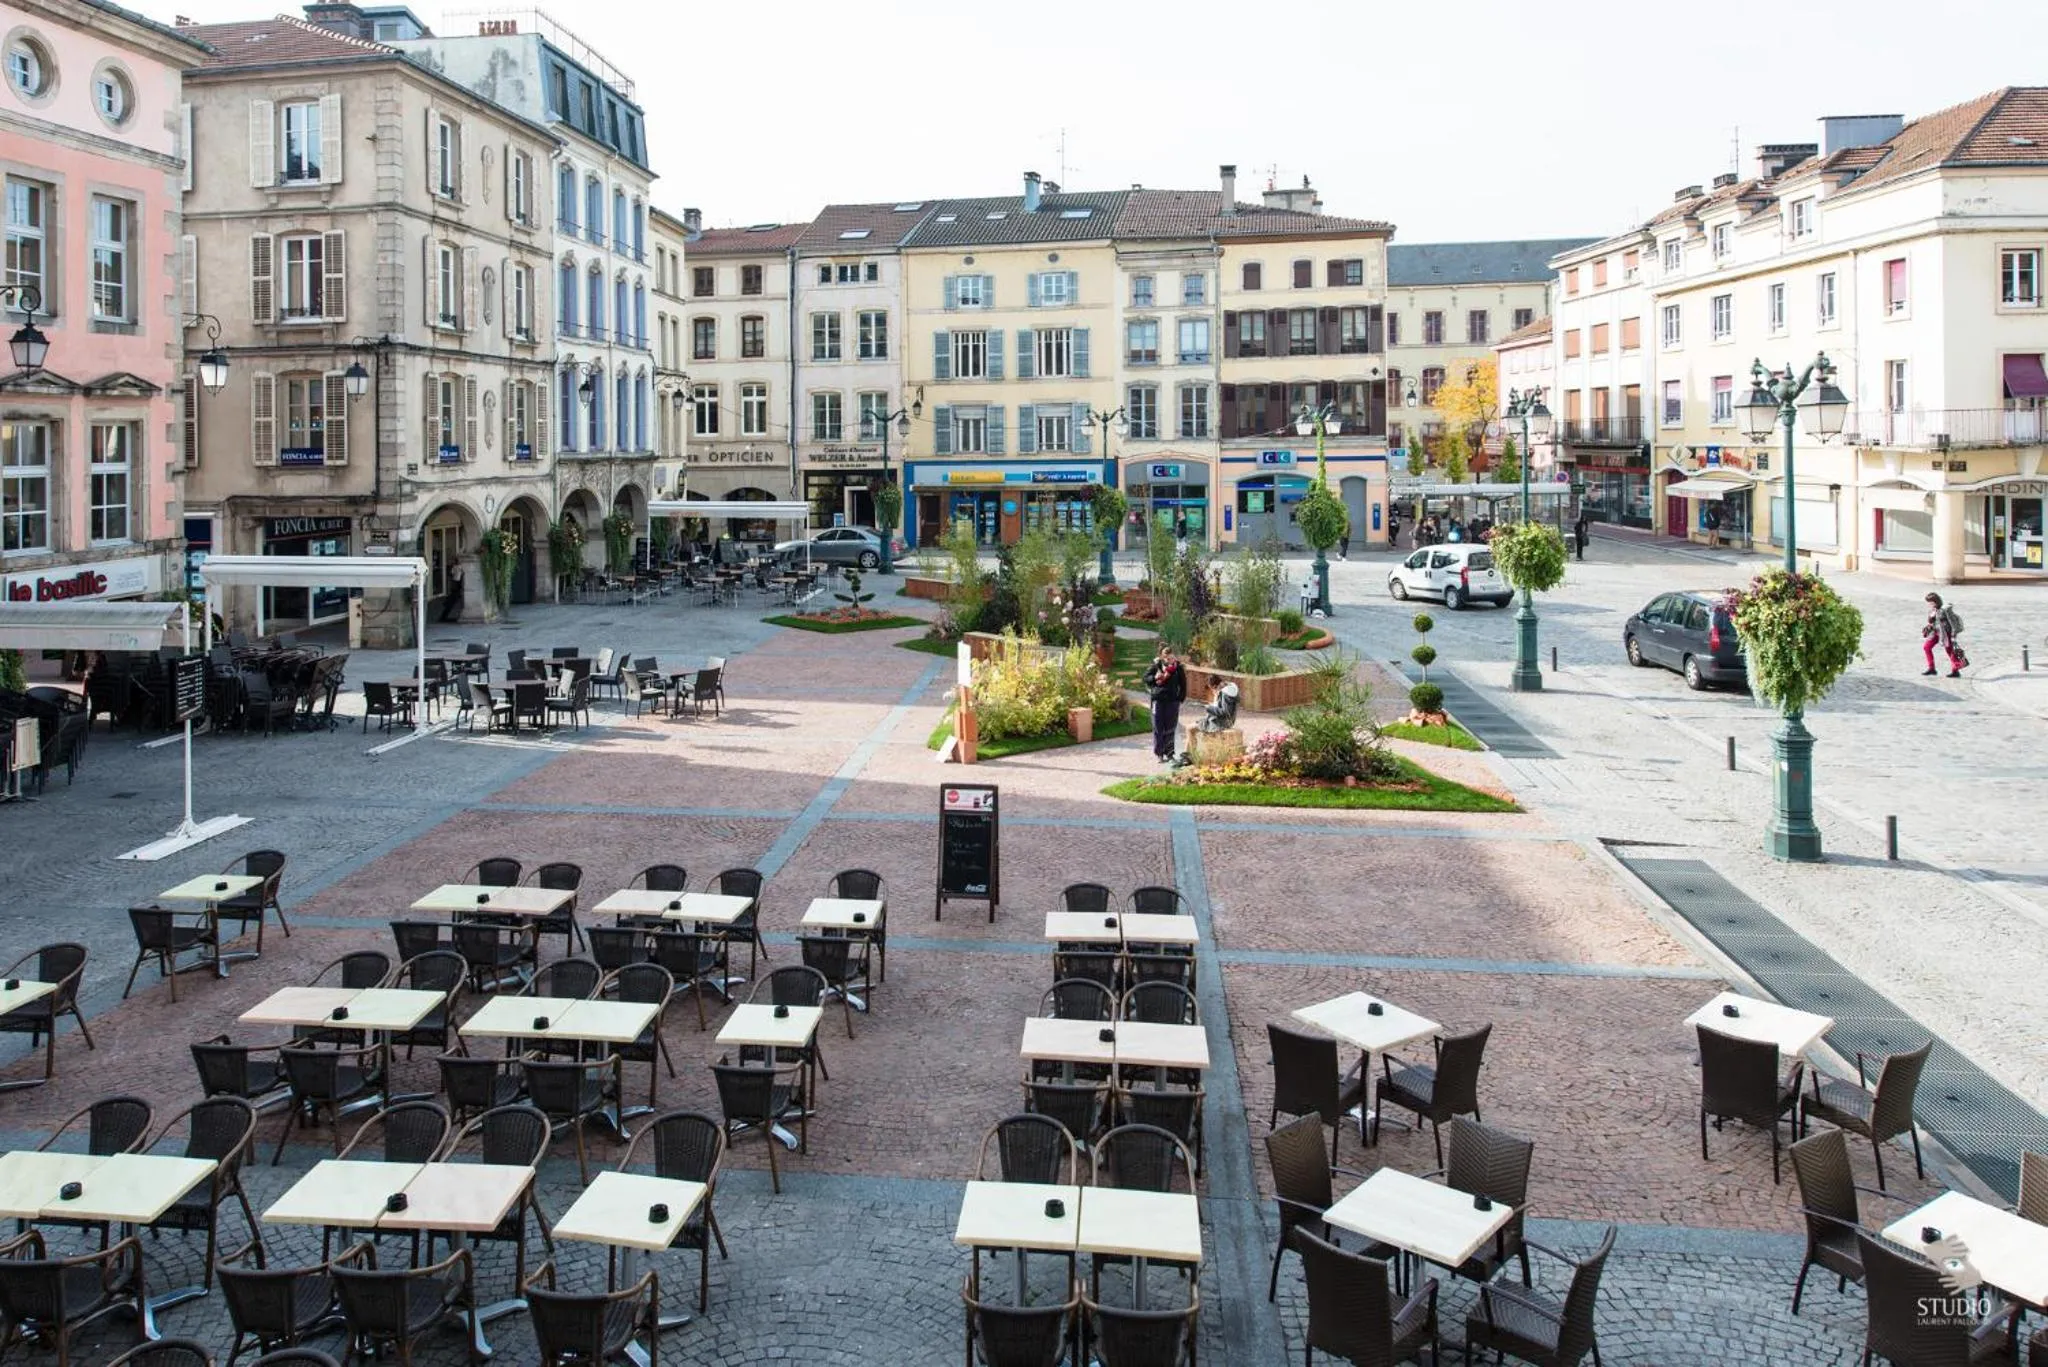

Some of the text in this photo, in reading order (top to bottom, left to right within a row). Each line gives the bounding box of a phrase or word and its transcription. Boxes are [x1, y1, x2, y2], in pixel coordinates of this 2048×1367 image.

[709, 452, 774, 462] OPTICIEN
[1263, 452, 1291, 463] CIC
[1153, 466, 1179, 477] CIC
[275, 517, 317, 535] FONCIA
[37, 571, 108, 600] basilic
